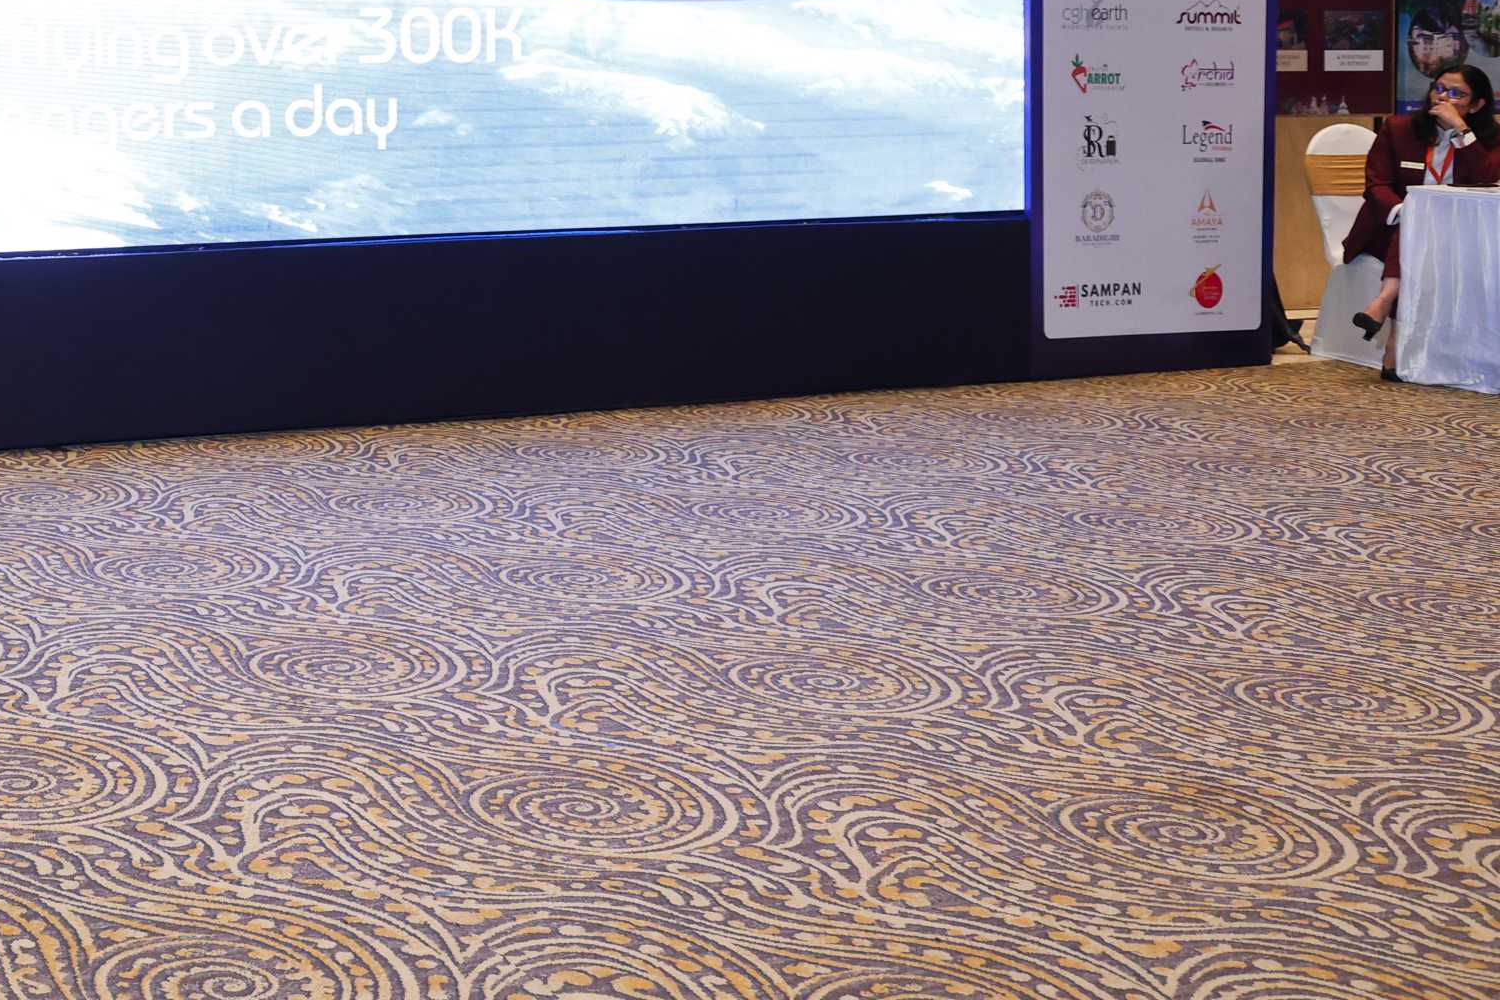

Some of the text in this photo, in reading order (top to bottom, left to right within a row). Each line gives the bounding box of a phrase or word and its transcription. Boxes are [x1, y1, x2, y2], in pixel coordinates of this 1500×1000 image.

[1176, 10, 1242, 24] summit
[357, 6, 524, 65] 300K
[231, 99, 271, 139] a
[285, 83, 399, 151] day
[1182, 124, 1233, 152] Legend
[1081, 282, 1142, 297] SAMPAN
